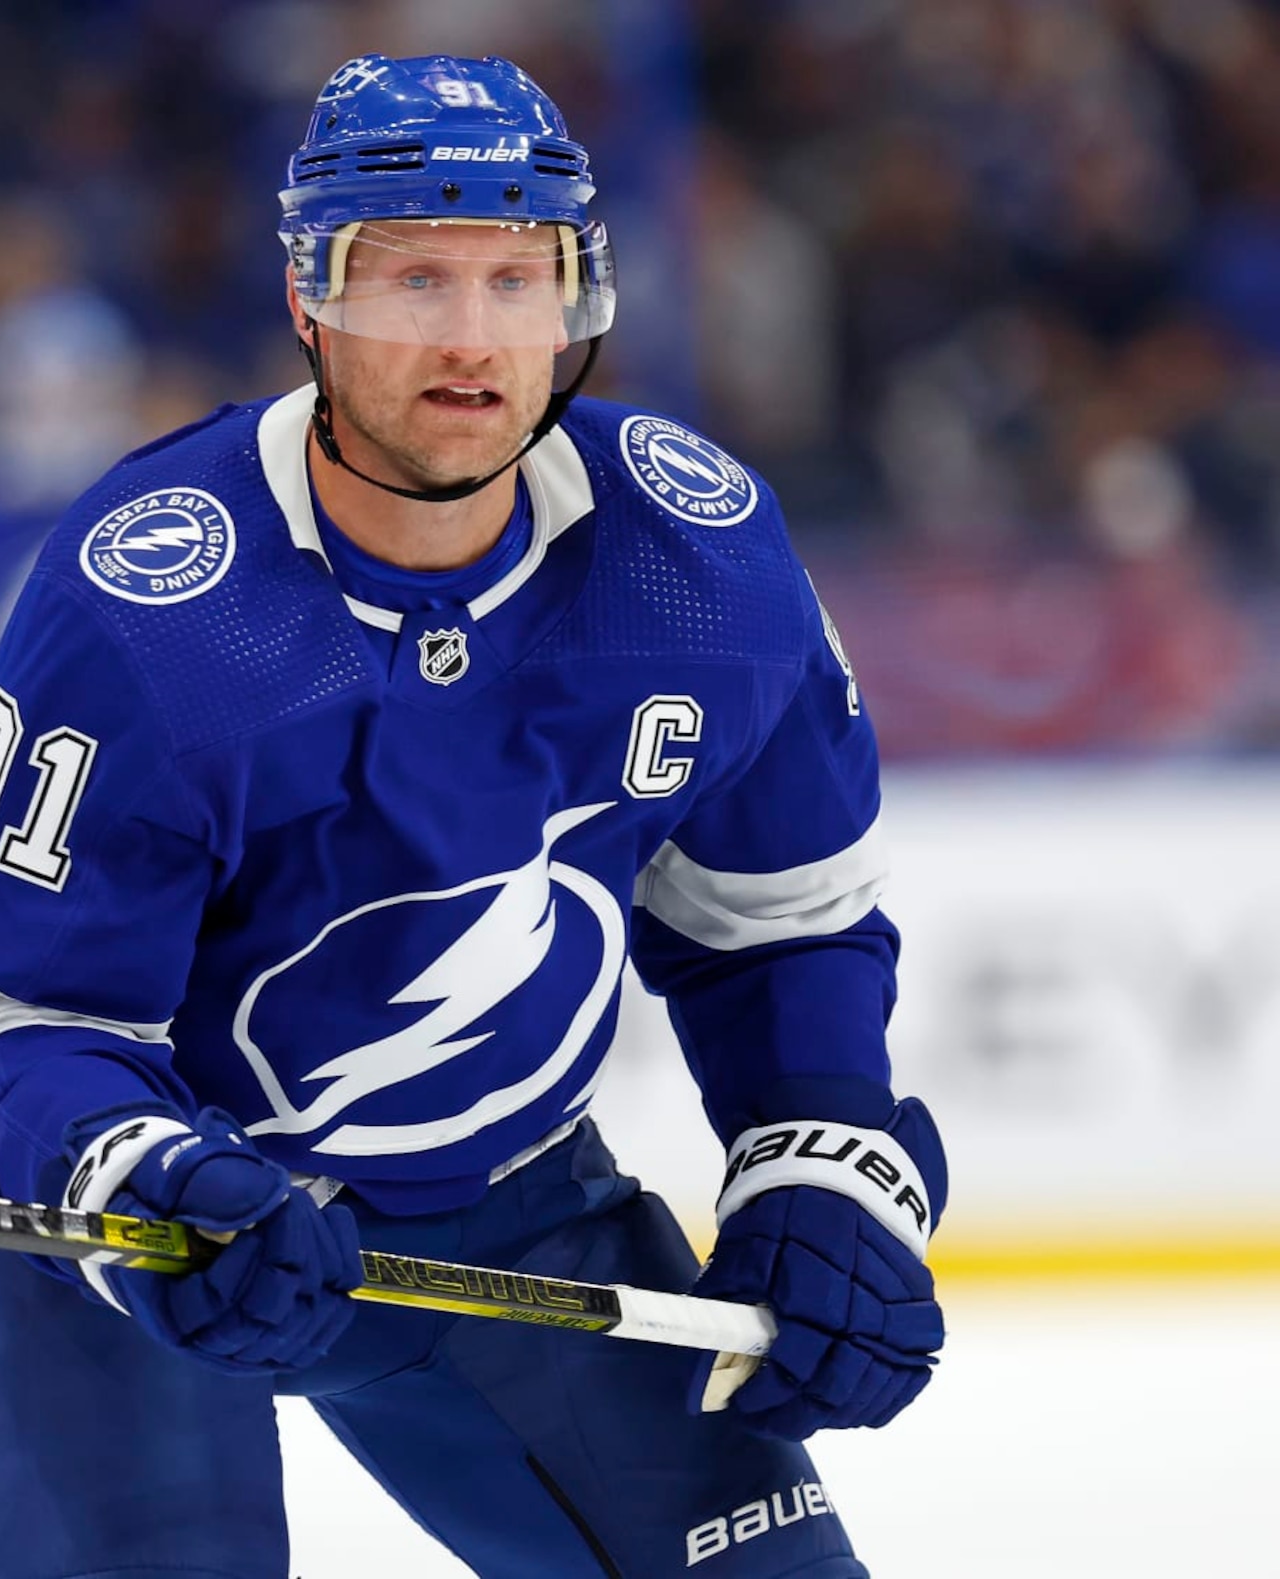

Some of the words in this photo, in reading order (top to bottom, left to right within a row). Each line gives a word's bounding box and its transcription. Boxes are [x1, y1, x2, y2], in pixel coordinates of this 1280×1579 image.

[436, 81, 497, 109] 91
[630, 421, 700, 456] LIGHTNING
[637, 462, 671, 495] BAY
[97, 498, 160, 539] TAMPA
[167, 494, 209, 513] BAY
[676, 492, 739, 515] TAMPA
[149, 513, 225, 592] LIGHTNING
[431, 643, 459, 674] NHL
[622, 695, 704, 799] C
[686, 1482, 835, 1568] BAUE
